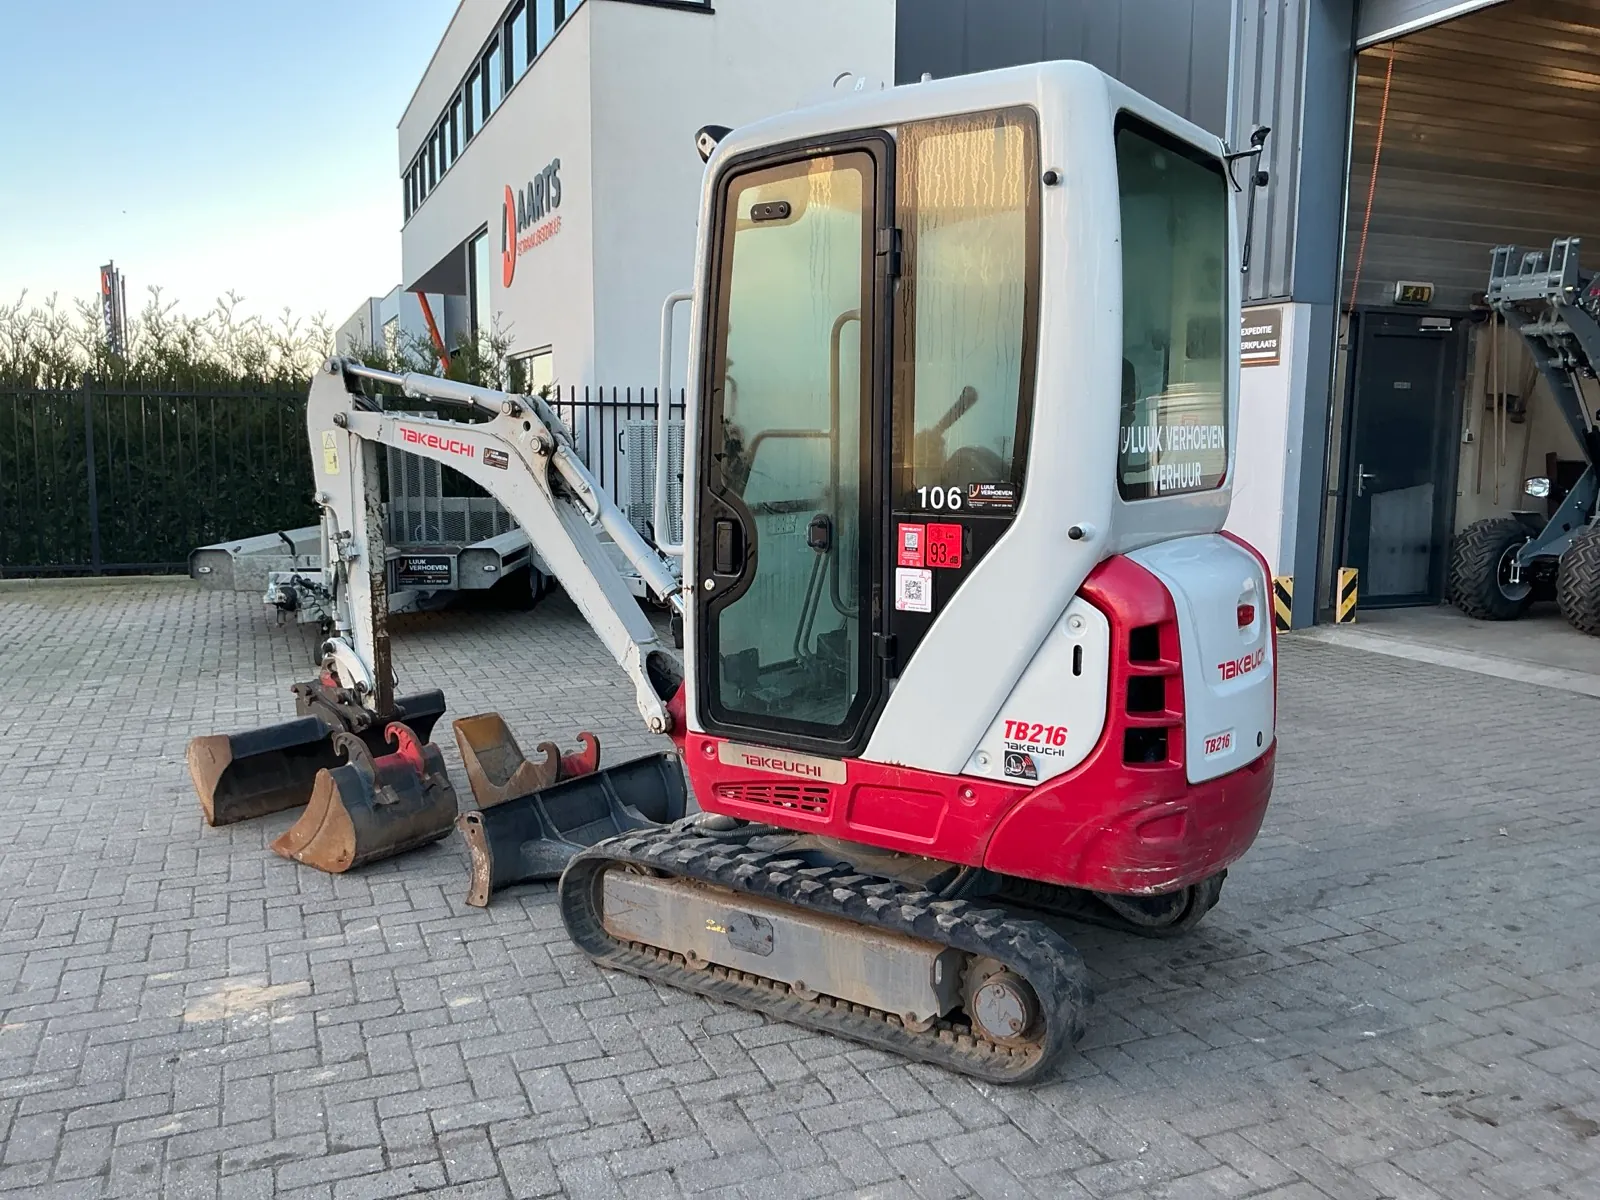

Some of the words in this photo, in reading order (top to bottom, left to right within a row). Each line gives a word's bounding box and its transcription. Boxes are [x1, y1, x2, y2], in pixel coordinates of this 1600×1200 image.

[517, 157, 562, 234] AARTS
[1240, 325, 1272, 336] EXPEDITIE
[1240, 339, 1277, 350] ERKPLAATS
[400, 428, 474, 457] TAKEUCHI
[1131, 425, 1162, 453] LUUK
[1166, 425, 1225, 451] VERHOEVEN
[1152, 462, 1201, 491] VERHUUR
[917, 486, 962, 510] 106
[931, 543, 947, 563] 93
[1218, 648, 1265, 681] TAKEUC
[1005, 720, 1068, 747] TB216
[1205, 733, 1231, 754] TB216
[1004, 741, 1065, 757] TAKEUCHI
[741, 753, 822, 777] TAKEUCHI
